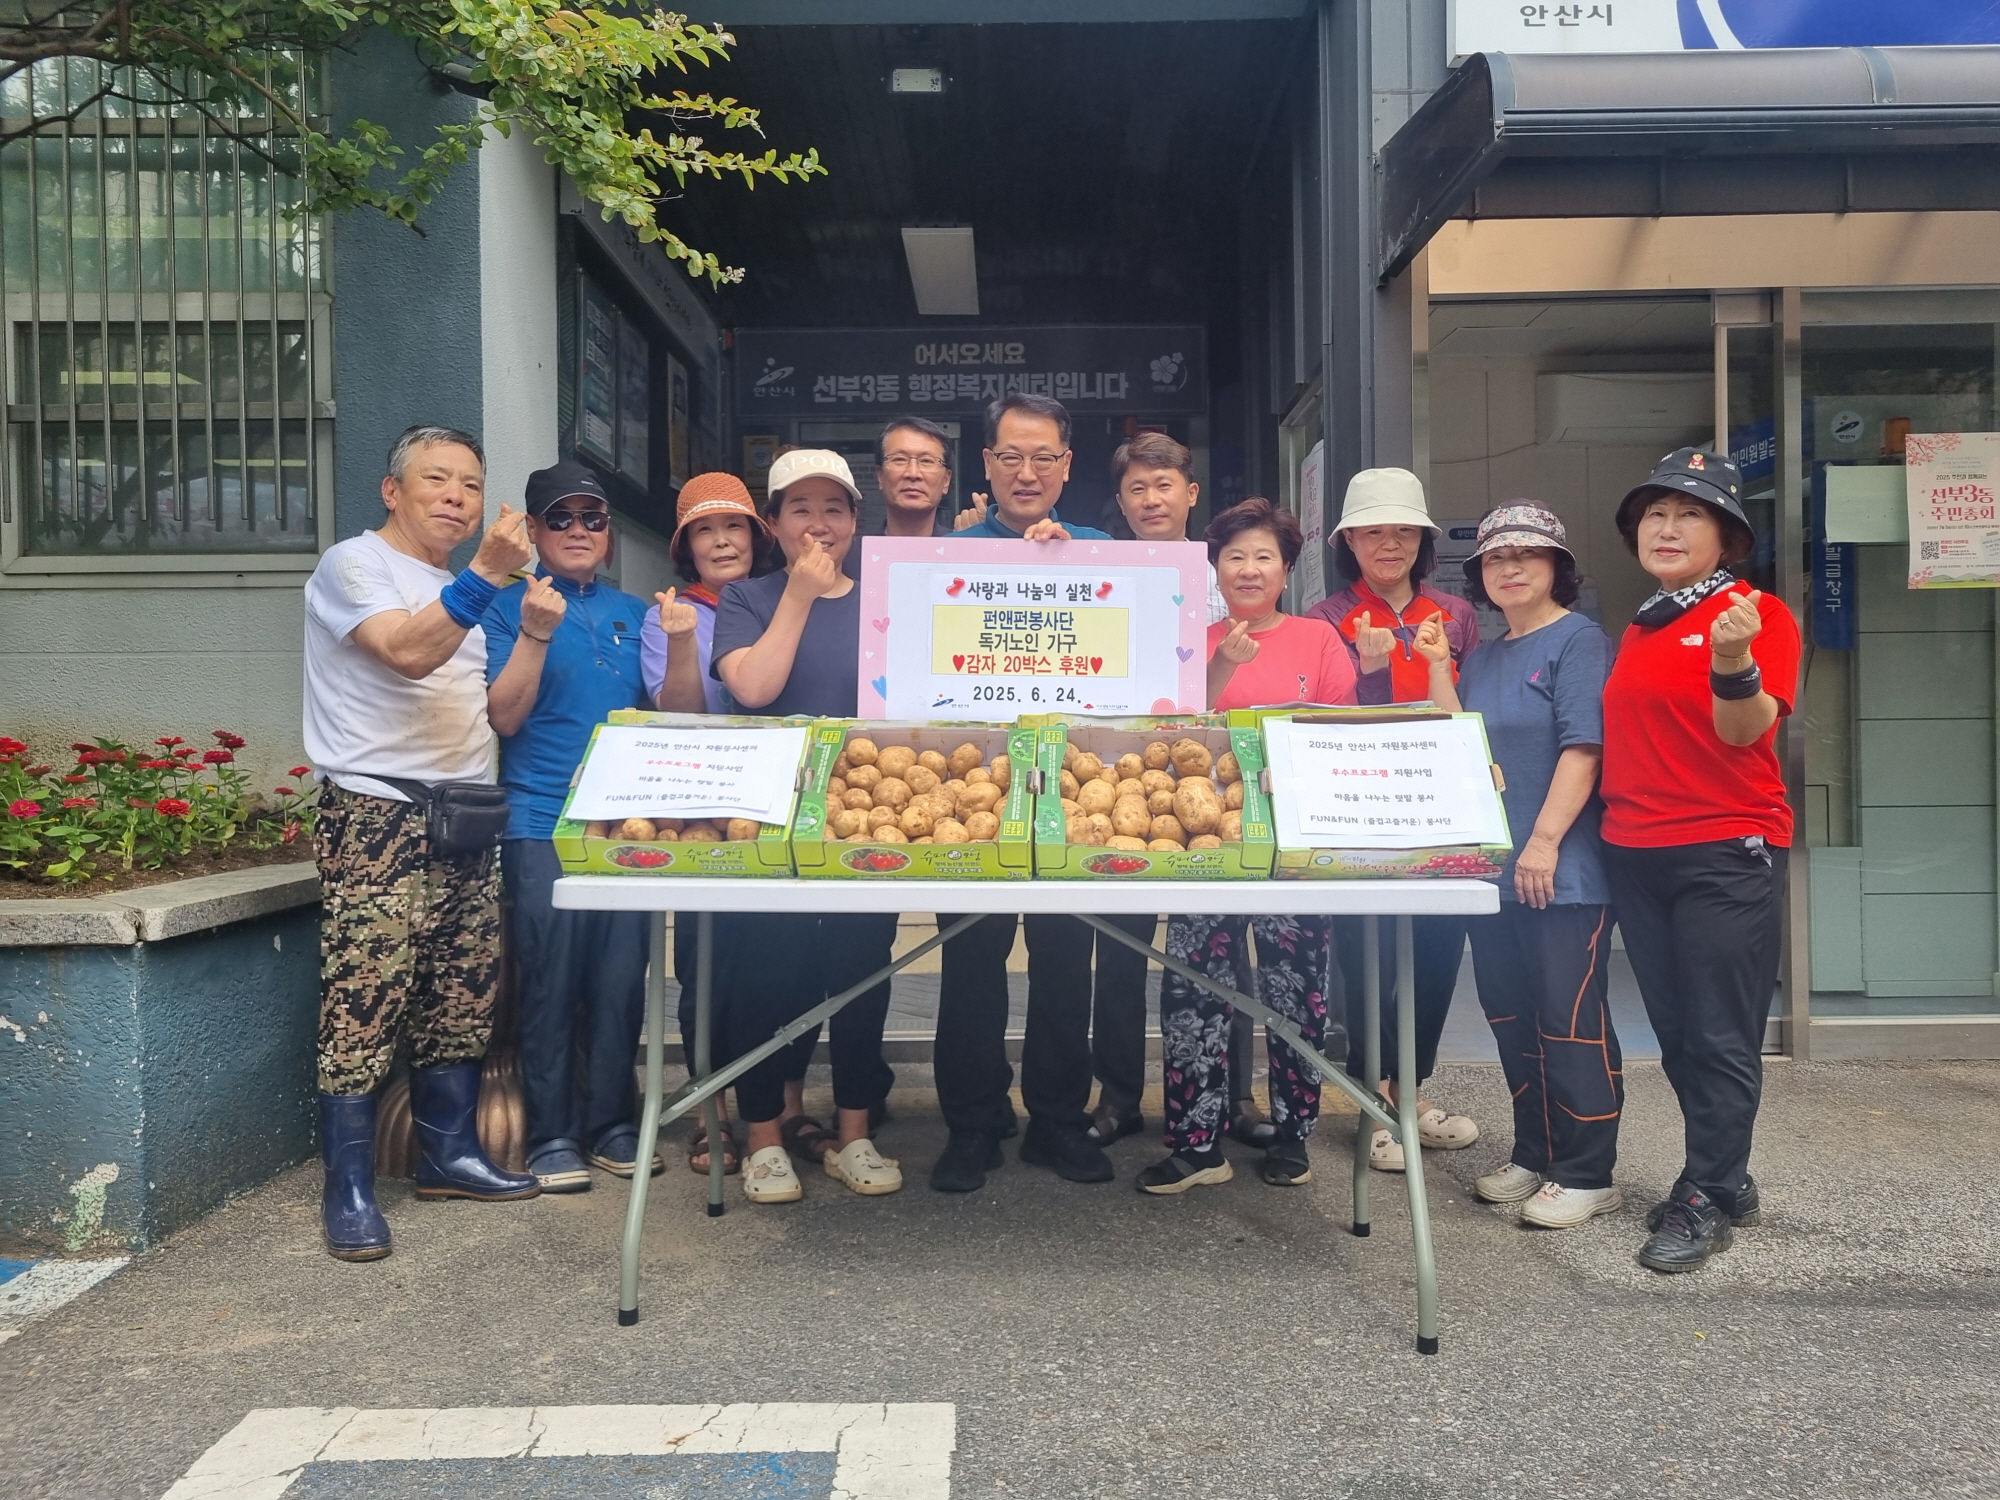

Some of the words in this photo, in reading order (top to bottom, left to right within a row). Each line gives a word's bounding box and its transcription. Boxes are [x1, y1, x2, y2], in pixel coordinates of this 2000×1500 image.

[1519, 4, 1614, 27] 안산시
[914, 342, 1026, 365] 어서오세요
[753, 385, 795, 397] 안산시
[813, 374, 900, 403] 선부3동
[908, 372, 1129, 402] 행정복지센터입니다
[1930, 484, 1994, 504] 선부3동
[1930, 506, 1995, 521] 주민총회
[1825, 546, 1843, 613] 발급창구
[967, 581, 1009, 600] 사랑과
[1017, 582, 1057, 600] 나눔의
[1066, 583, 1092, 602] 실천
[983, 610, 1074, 631] 펀앤펀봉사단
[978, 632, 1039, 653] 독거노인
[1047, 634, 1078, 653] 가구
[967, 654, 996, 674] 감자
[1004, 655, 1052, 674] 20박스
[1059, 655, 1089, 676] 후원
[973, 686, 1021, 702] 2025.
[1031, 687, 1046, 703] 6.
[1056, 687, 1081, 703] 24.
[635, 740, 669, 750] 2025년
[673, 742, 701, 751] 안산시
[705, 743, 758, 752] 자원봉사센터
[1309, 740, 1343, 750] 2025년
[1348, 742, 1376, 751] 안산시
[1381, 740, 1437, 750] 자원봉사센터
[646, 759, 702, 769] 우수프로그램
[707, 763, 744, 772] 지원사업
[1331, 768, 1389, 778] 우수프로그램
[1394, 768, 1432, 777] 지원사업
[638, 775, 662, 783] 마음을
[605, 794, 652, 802] FUN&FUN
[1334, 793, 1360, 802] 마음을
[1365, 794, 1390, 802] 나누는
[1395, 794, 1412, 803] 텃밭
[1417, 794, 1434, 802] 봉사
[1310, 815, 1358, 824] FUN&FUN
[1363, 816, 1421, 826] (즐겁고즐거운)
[1426, 817, 1451, 826] 봉사단
